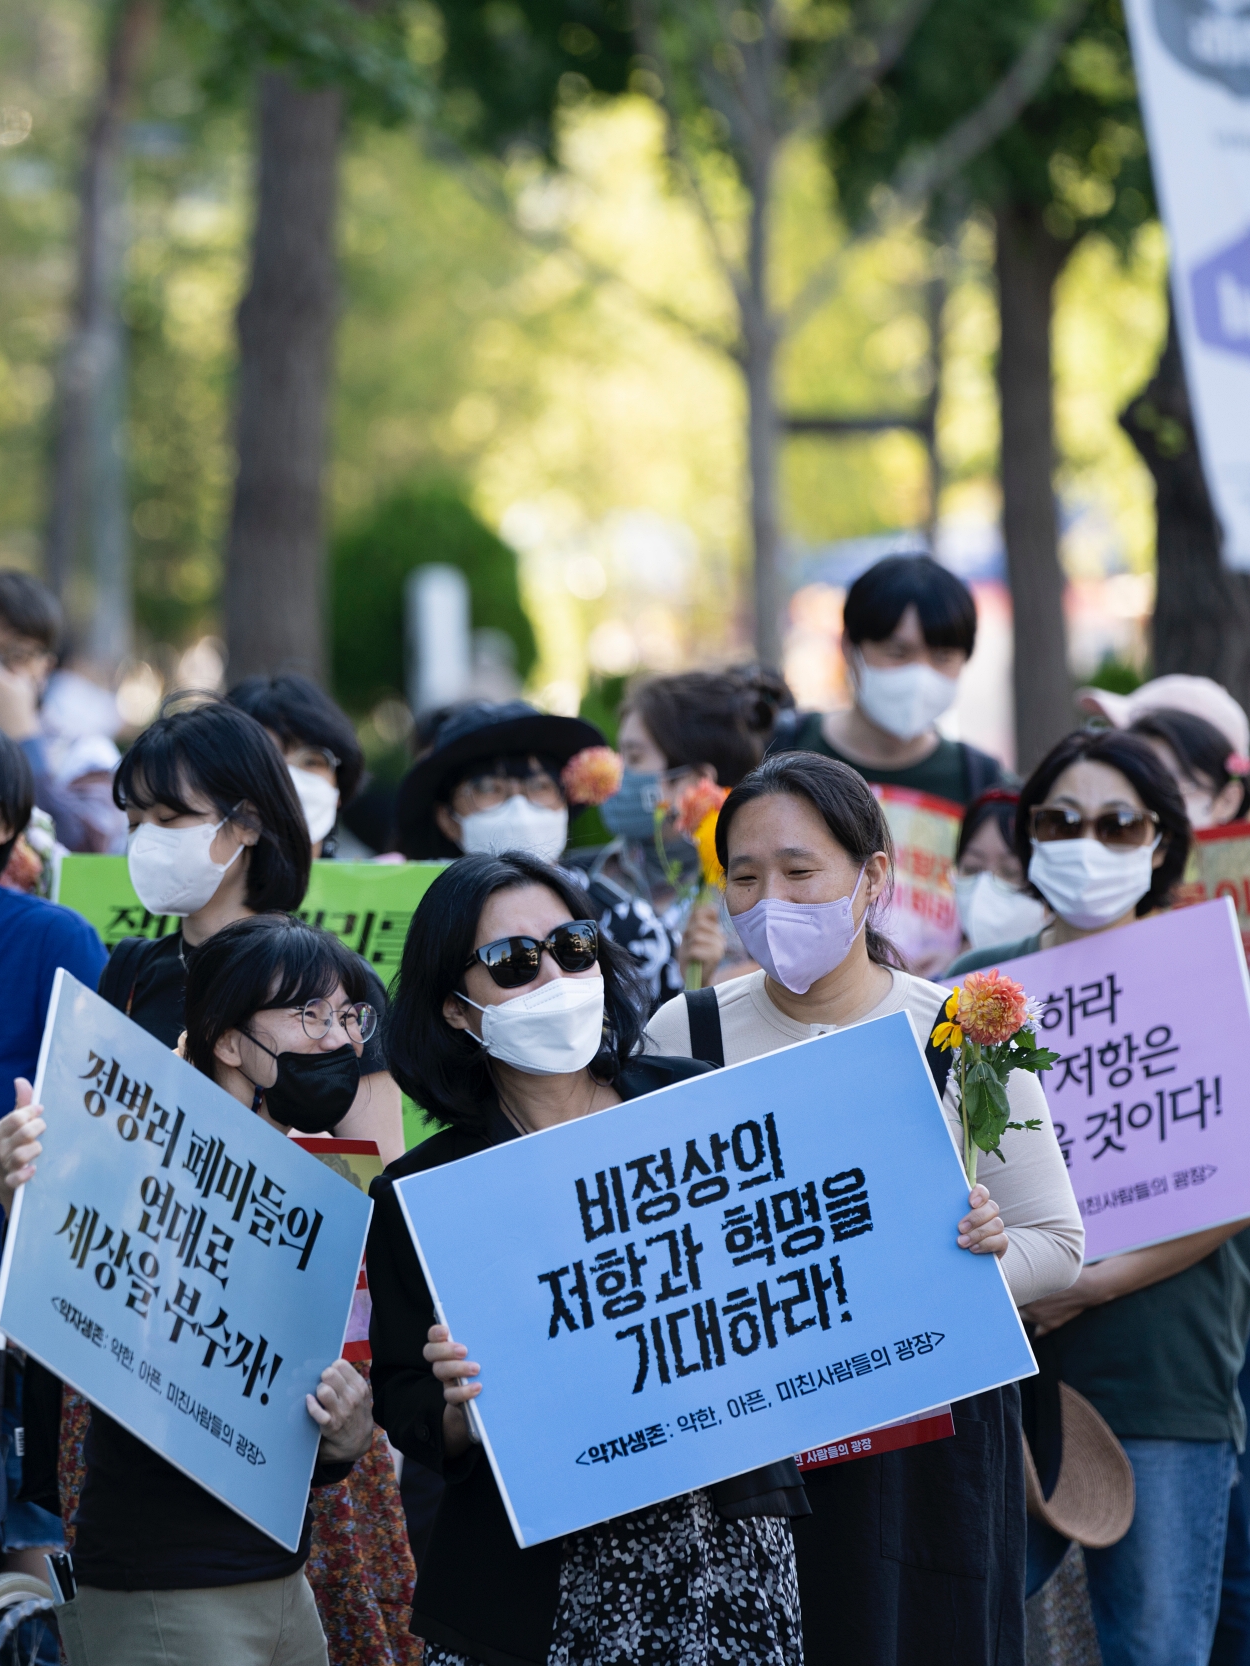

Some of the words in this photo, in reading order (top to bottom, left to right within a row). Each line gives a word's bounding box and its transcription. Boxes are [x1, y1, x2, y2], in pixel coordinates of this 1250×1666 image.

[1054, 1025, 1180, 1096] 저항은
[1084, 1075, 1223, 1162] 것이다!
[138, 1175, 235, 1289] 연대로
[182, 1129, 324, 1271] 페미들의
[574, 1112, 785, 1243] 비정상의
[55, 1202, 161, 1320] 세상을
[164, 1277, 284, 1406] 부수자!
[538, 1223, 703, 1339] 저항과
[721, 1167, 874, 1268] 혁명을
[615, 1256, 853, 1394] 기대하라!
[166, 1382, 235, 1447] 미친사람들의
[676, 1403, 723, 1436] 약한,
[726, 1389, 772, 1418] 아픈,
[775, 1347, 892, 1402] 미친사람들의
[894, 1331, 946, 1364] 광장>
[806, 1443, 849, 1464] 사람들의
[850, 1437, 872, 1453] 광장
